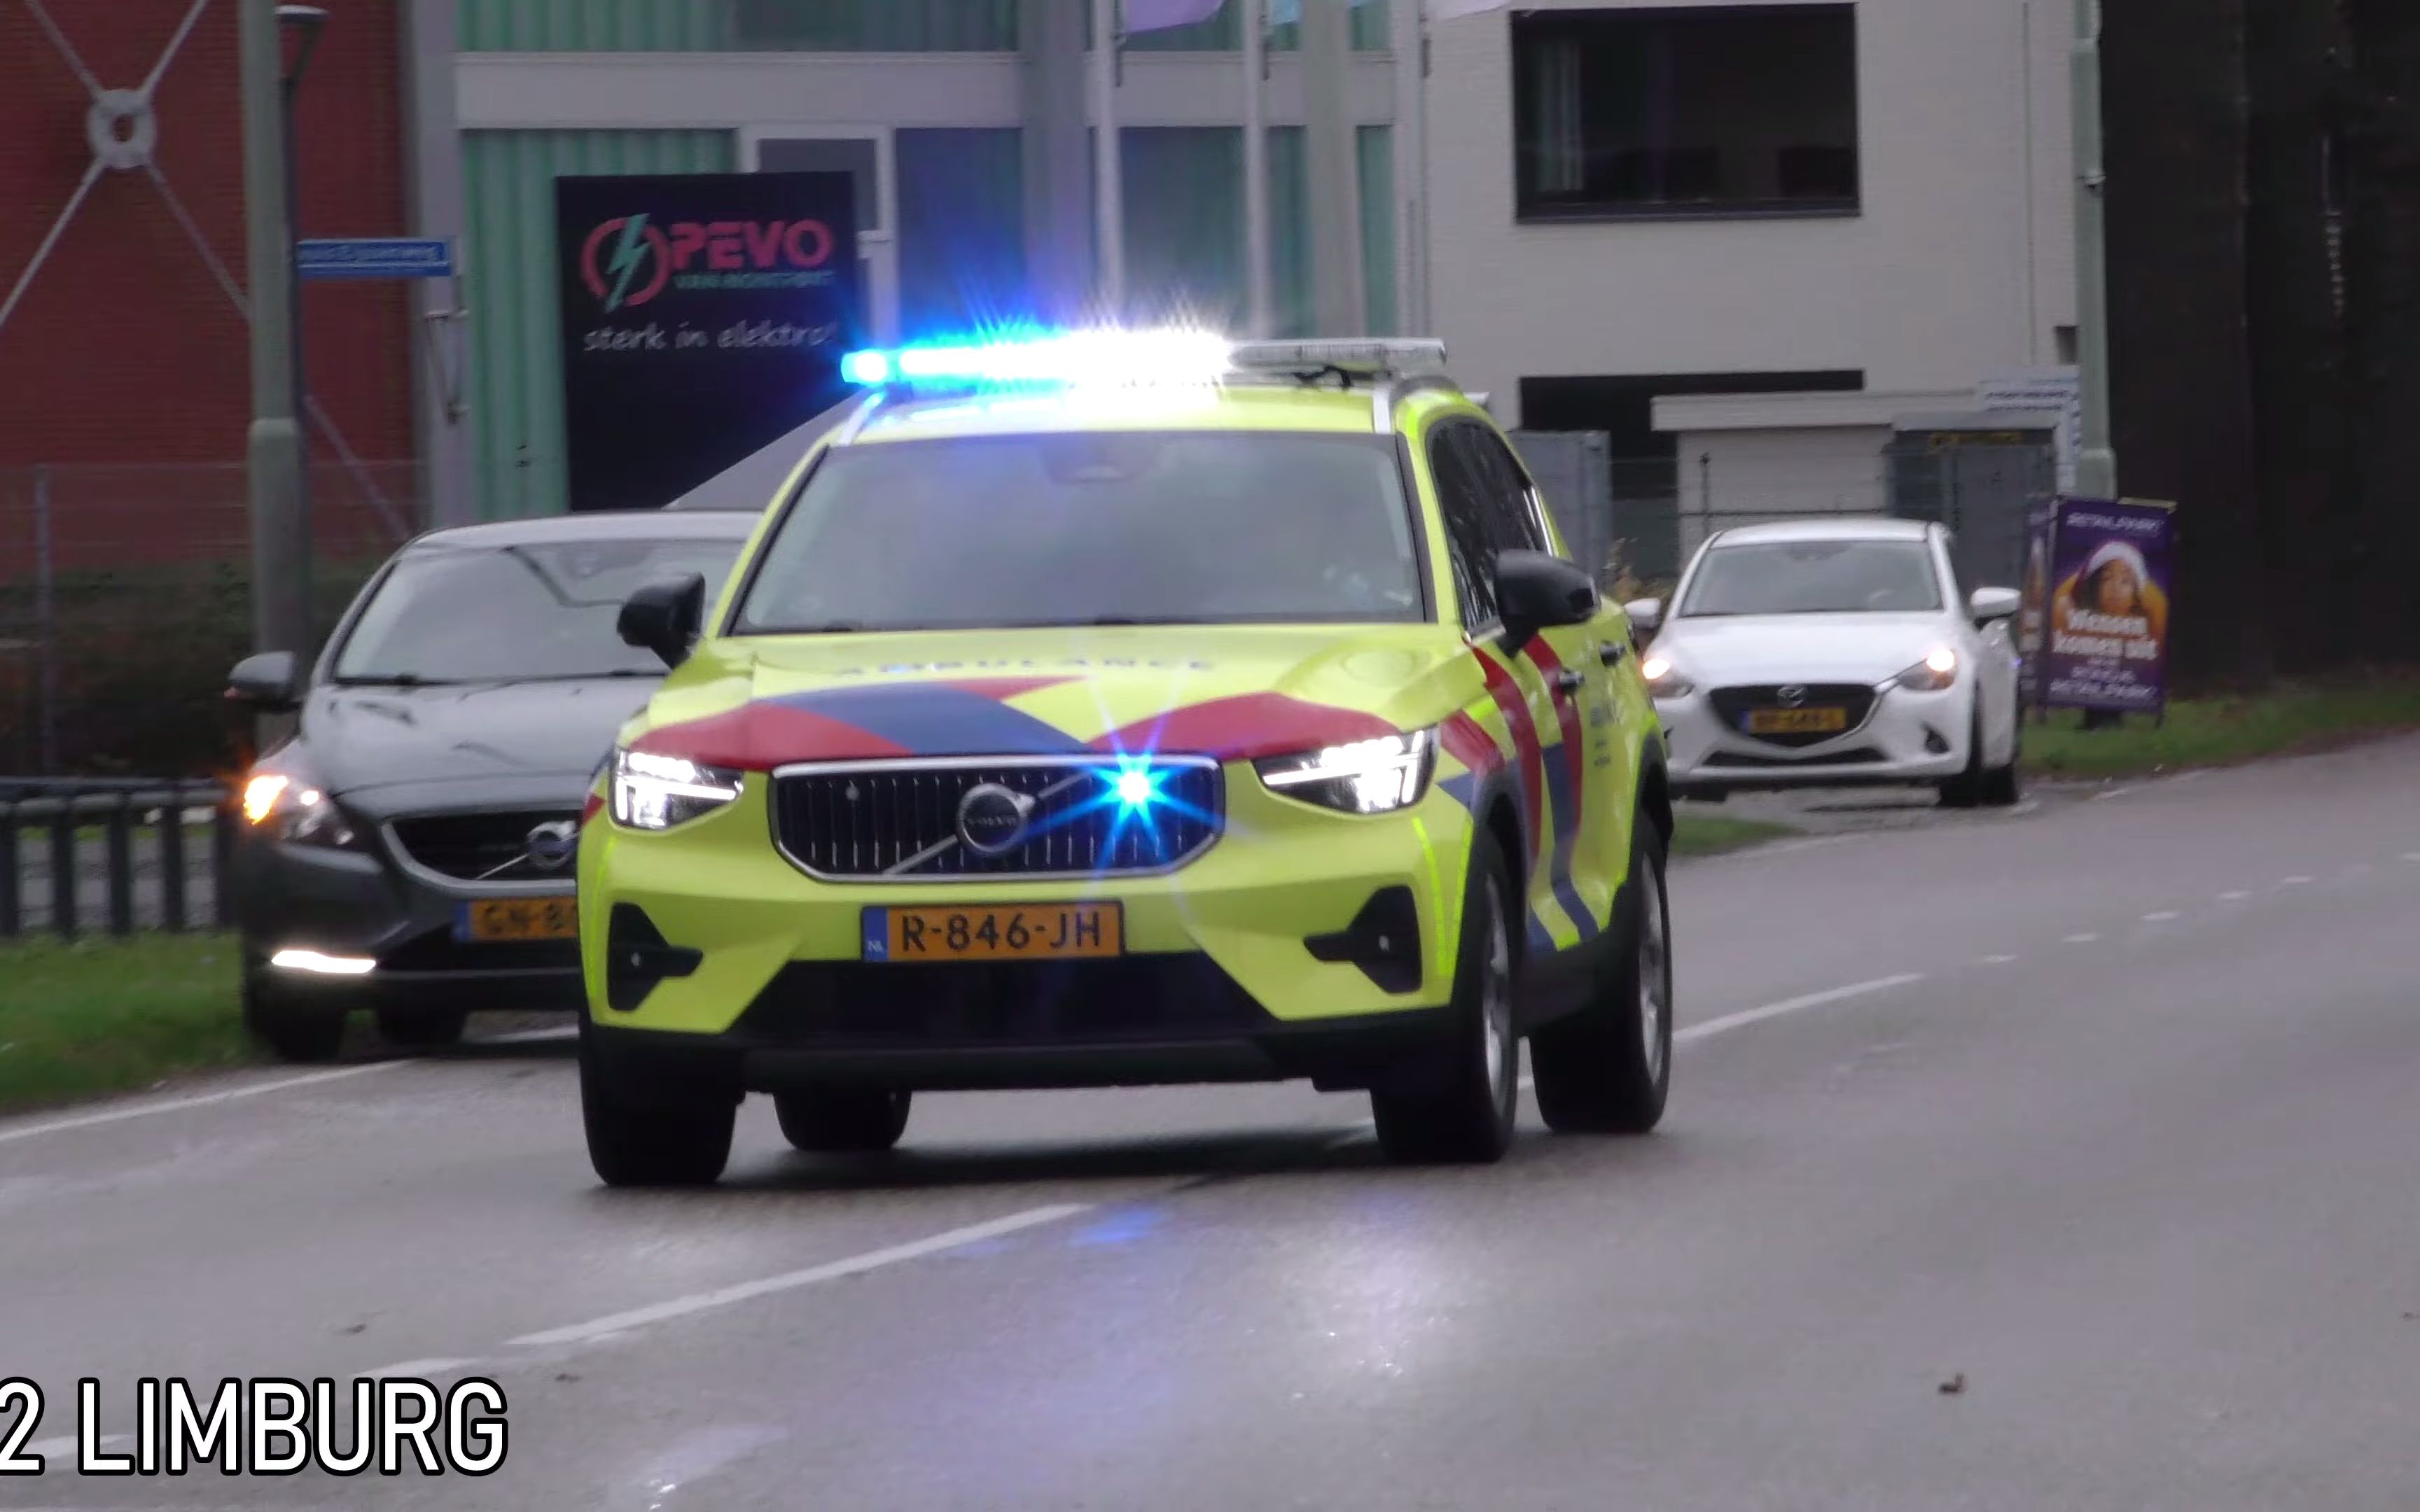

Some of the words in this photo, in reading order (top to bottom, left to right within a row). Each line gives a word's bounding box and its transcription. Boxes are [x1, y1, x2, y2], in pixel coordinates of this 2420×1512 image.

[668, 219, 835, 270] PEVO
[583, 322, 667, 351] sterk
[675, 320, 708, 348] in
[901, 911, 1101, 953] R-846-JH
